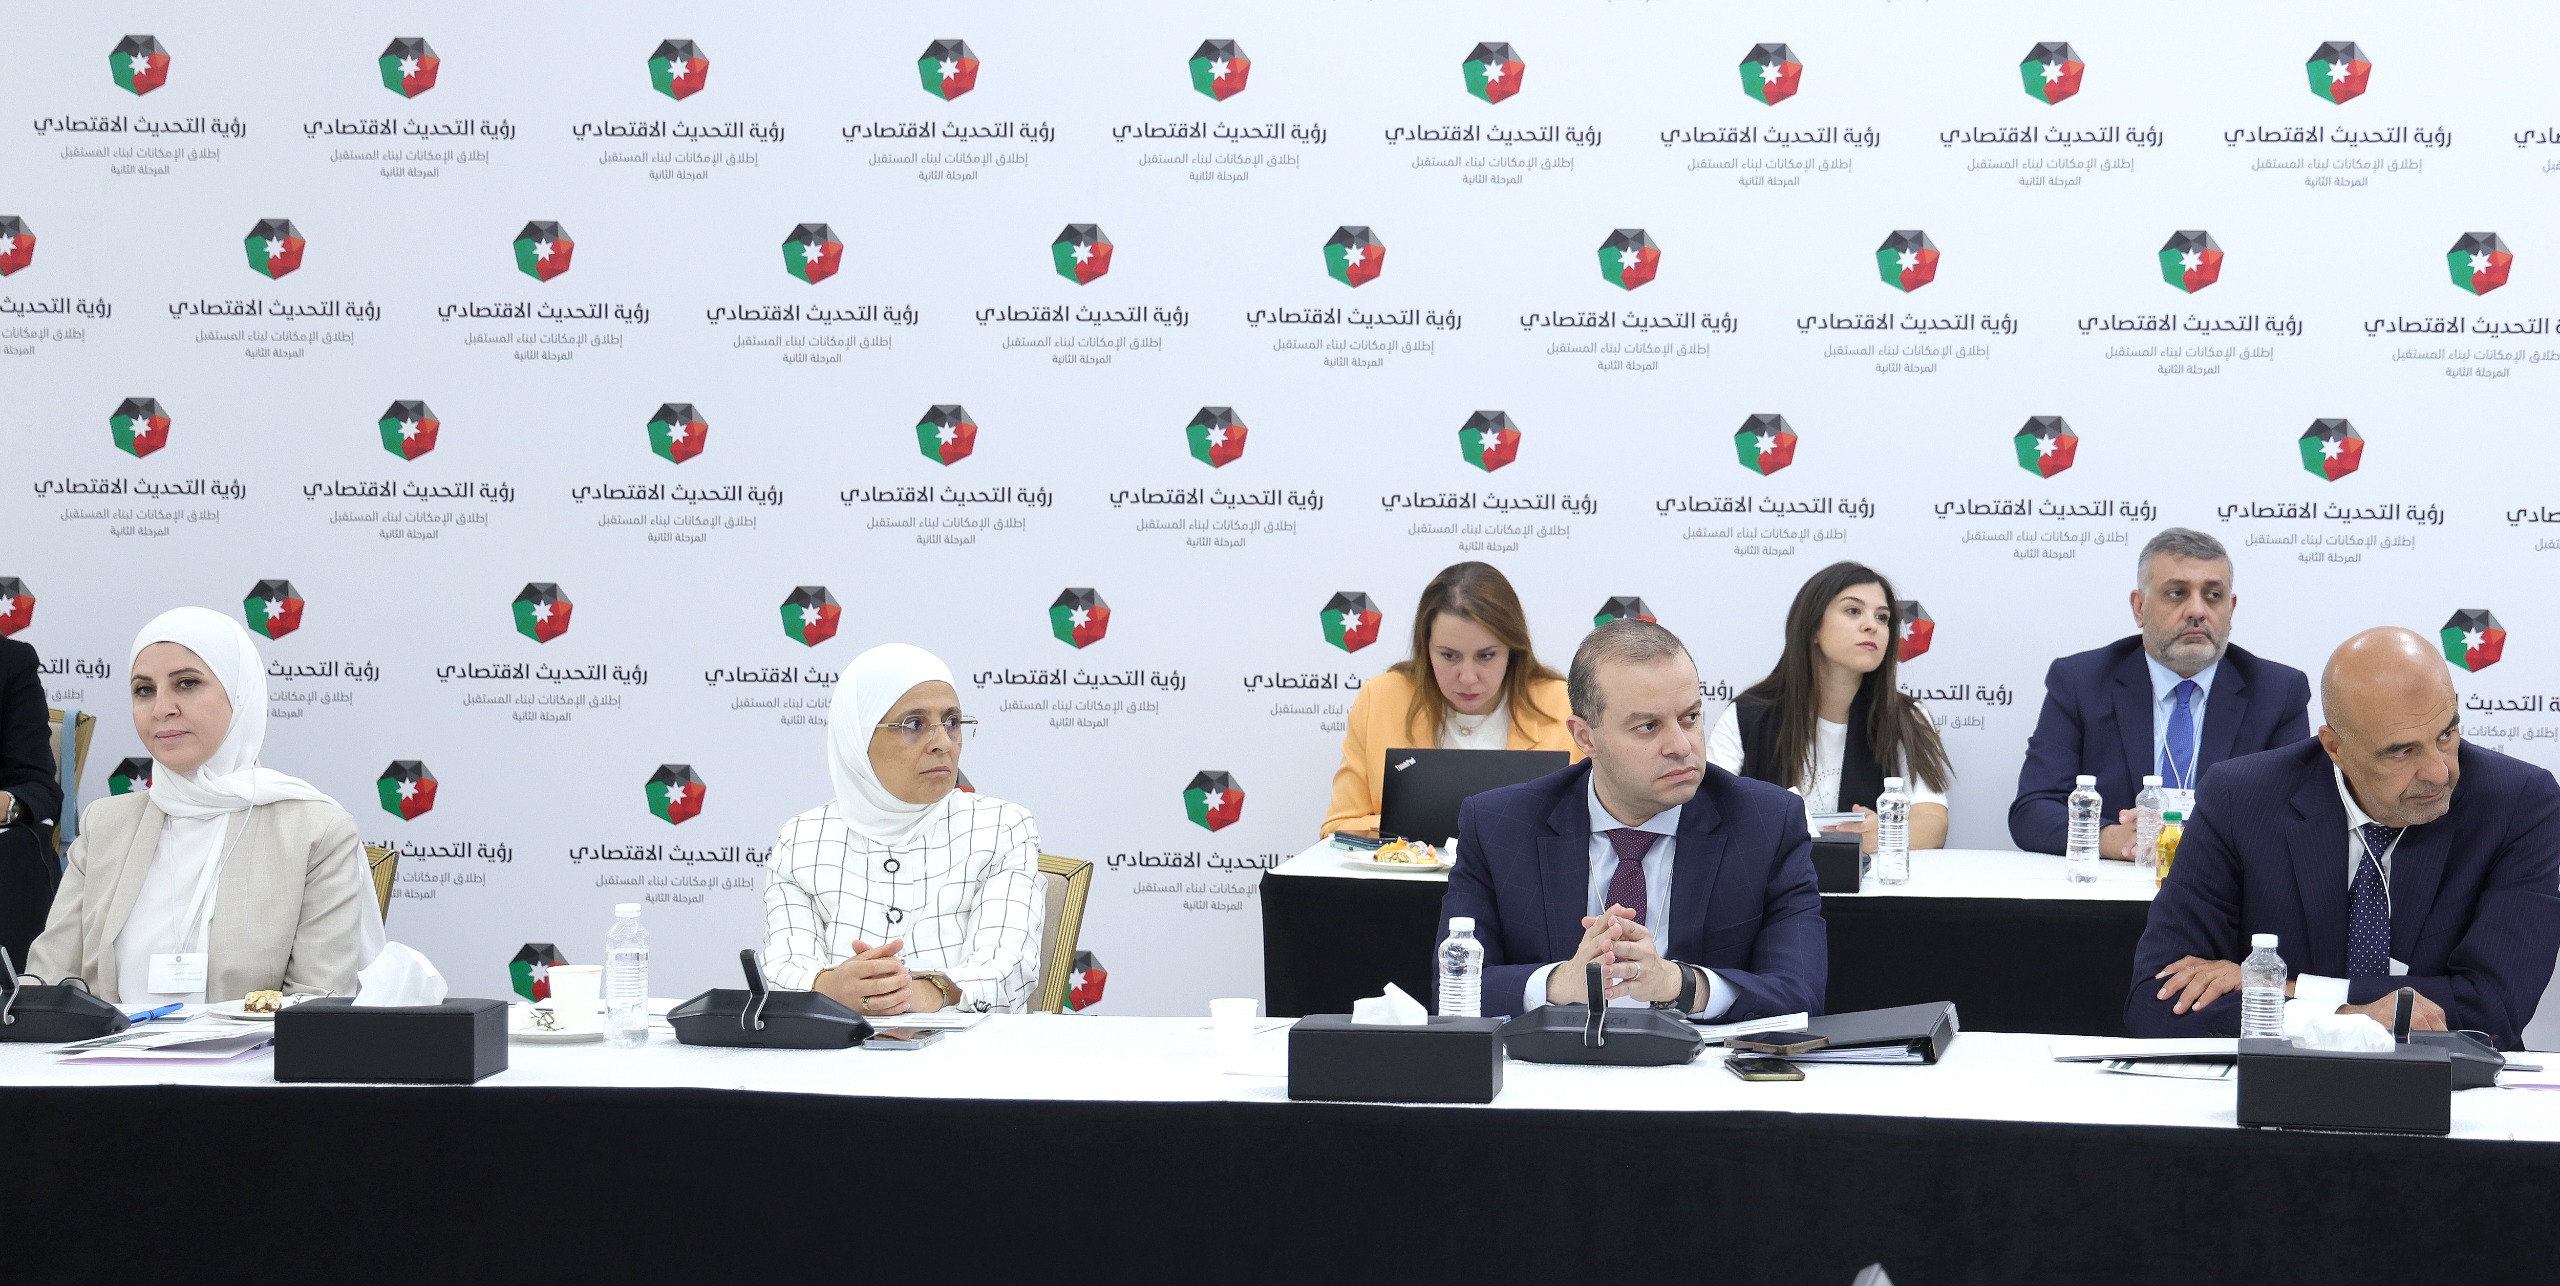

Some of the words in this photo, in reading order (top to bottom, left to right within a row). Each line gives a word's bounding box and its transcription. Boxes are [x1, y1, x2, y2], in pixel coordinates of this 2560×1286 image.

[33, 114, 128, 137] الاقتصادي
[133, 115, 206, 138] التحديث
[210, 116, 247, 139] رؤية
[303, 117, 397, 140] الاقتصادي
[402, 117, 475, 141] التحديث
[479, 118, 516, 141] رؤية
[842, 120, 936, 144] الاقتصادي
[941, 120, 1014, 143] التحديث
[1019, 120, 1055, 144] رؤية
[1112, 121, 1207, 144] الاقتصادي
[1212, 121, 1286, 144] التحديث
[1290, 122, 1327, 145] رؤية
[1384, 124, 1481, 146] الاقتصادي
[1486, 124, 1560, 147] التحديث
[1564, 124, 1602, 148] رؤية
[1660, 125, 1757, 148] الاقتصادي
[2223, 125, 2324, 148] الاقتصادي
[2330, 125, 2408, 148] التحديث
[1762, 125, 1838, 149] التحديث
[1842, 125, 1880, 149] رؤية
[2412, 125, 2452, 149] رؤية
[329, 148, 380, 163] المستقبل
[382, 149, 403, 162] لبناء
[405, 149, 454, 165] الإمكانات
[456, 149, 489, 165] إطلاق
[1138, 152, 1189, 167] المستقبل
[1191, 152, 1212, 167] لبناء
[1215, 153, 1264, 169] الإمكانات
[1266, 153, 1300, 169] إطلاق
[2251, 157, 2305, 172] المستقبل
[2307, 158, 2329, 170] لبناء
[2332, 158, 2384, 174] الإمكانات
[2387, 158, 2423, 174] إطلاق
[379, 166, 405, 180] الثانية
[407, 166, 439, 180] المرحلة
[1188, 170, 1215, 183] الثانية
[1216, 170, 1249, 184] المرحلة
[2304, 176, 2332, 189] الثانية
[2333, 176, 2368, 189] المرحلة
[168, 298, 263, 320] الاقتصادي
[268, 298, 340, 322] التحديث
[344, 299, 381, 322] رؤية
[706, 303, 800, 326] الاقتصادي
[805, 303, 878, 326] التحديث
[882, 303, 919, 327] رؤية
[975, 304, 1070, 327] الاقتصادي
[1075, 304, 1148, 327] التحديث
[1152, 305, 1189, 328] رؤية
[1246, 306, 1342, 328] الاقتصادي
[1347, 307, 1420, 330] التحديث
[1425, 308, 1462, 331] رؤية
[1796, 312, 1894, 335] الاقتصادي
[1899, 312, 1975, 335] التحديث
[1980, 312, 2018, 336] رؤية
[2077, 313, 2177, 336] الاقتصادي
[2182, 313, 2260, 337] التحديث
[2264, 313, 2303, 337] رؤية
[733, 335, 782, 349] المستقبل
[785, 335, 806, 347] لبناء
[808, 335, 857, 351] الإمكانات
[859, 335, 892, 351] إطلاق
[1823, 344, 1875, 358] المستقبل
[1878, 344, 1899, 358] لبناء
[1902, 344, 1952, 360] الإمكانات
[782, 352, 808, 365] الثانية
[809, 352, 842, 366] المرحلة
[1955, 345, 1990, 360] إطلاق
[1875, 362, 1901, 375] الثانية
[1903, 362, 1937, 375] المرحلة
[33, 476, 128, 499] الاقتصادي
[133, 477, 206, 500] التحديث
[210, 478, 247, 501] رؤية
[302, 479, 397, 502] الاقتصادي
[402, 480, 474, 503] التحديث
[479, 480, 515, 504] رؤية
[571, 482, 665, 504] الاقتصادي
[670, 483, 743, 506] التحديث
[747, 484, 784, 507] رؤية
[1109, 487, 1204, 509] الاقتصادي
[1209, 487, 1283, 510] التحديث
[1287, 488, 1324, 512] رؤية
[1381, 491, 1477, 513] الاقتصادي
[1482, 492, 1556, 515] التحديث
[1560, 492, 1598, 516] رؤية
[1655, 495, 1753, 517] الاقتصادي
[1757, 495, 1833, 519] التحديث
[1837, 496, 1875, 520] رؤية
[1933, 498, 2032, 520] الاقتصادي
[2037, 498, 2114, 521] التحديث
[2118, 499, 2157, 522] رؤية
[60, 507, 110, 522] المستقبل
[112, 508, 133, 521] لبناء
[135, 508, 184, 524] الإمكانات
[186, 508, 220, 523] إطلاق
[2217, 501, 2318, 523] الاقتصادي
[2323, 501, 2401, 525] التحديث
[2405, 503, 2445, 526] رؤية
[109, 525, 136, 538] الثانية
[137, 526, 170, 539] المرحلة
[1407, 522, 1458, 536] المستقبل
[1461, 523, 1482, 537] لبناء
[1484, 523, 1534, 539] الإمكانات
[1536, 524, 1570, 540] إطلاق
[2245, 533, 2298, 547] المستقبل
[2300, 533, 2323, 546] لبناء
[1458, 541, 1484, 553] الثانية
[1486, 541, 1519, 554] المرحلة
[2325, 534, 2377, 550] الإمكانات
[2379, 535, 2416, 551] إطلاق
[2297, 551, 2325, 565] الثانية
[2327, 552, 2362, 565] المرحلة
[74, 657, 111, 680] رؤية
[266, 659, 339, 682] التحديث
[343, 659, 380, 683] رؤية
[436, 661, 530, 684] الاقتصادي
[535, 662, 607, 685] التحديث
[611, 663, 648, 686] رؤية
[704, 665, 798, 687] الاقتصادي
[972, 667, 1067, 690] الاقتصادي
[1072, 668, 1145, 691] التحديث
[1149, 669, 1186, 692] رؤية
[1243, 671, 1338, 693] الاقتصادي
[462, 693, 512, 707] المستقبل
[514, 693, 535, 707] لبناء
[537, 693, 586, 709] الإمكانات
[588, 694, 621, 710] إطلاق
[999, 699, 1049, 713] المستقبل
[1974, 683, 2014, 707] رؤية
[2465, 693, 2544, 716] التحديث
[512, 711, 538, 724] الثانية
[539, 711, 572, 724] المرحلة
[1051, 699, 1073, 714] لبناء
[1075, 699, 1124, 715] الإمكانات
[1126, 700, 1159, 716] إطلاق
[1049, 717, 1075, 729] الثانية
[1076, 717, 1109, 730] المرحلة
[400, 840, 472, 863] التحديث
[476, 841, 513, 864] رؤية
[569, 843, 663, 865] الاقتصادي
[668, 844, 740, 867] التحديث
[1106, 850, 1201, 872] الاقتصادي
[595, 874, 645, 888] المستقبل
[647, 875, 668, 889] لبناء
[670, 875, 719, 891] الإمكانات
[721, 876, 754, 892] إطلاق
[644, 892, 671, 905] الثانية
[671, 893, 704, 906] المرحلة
